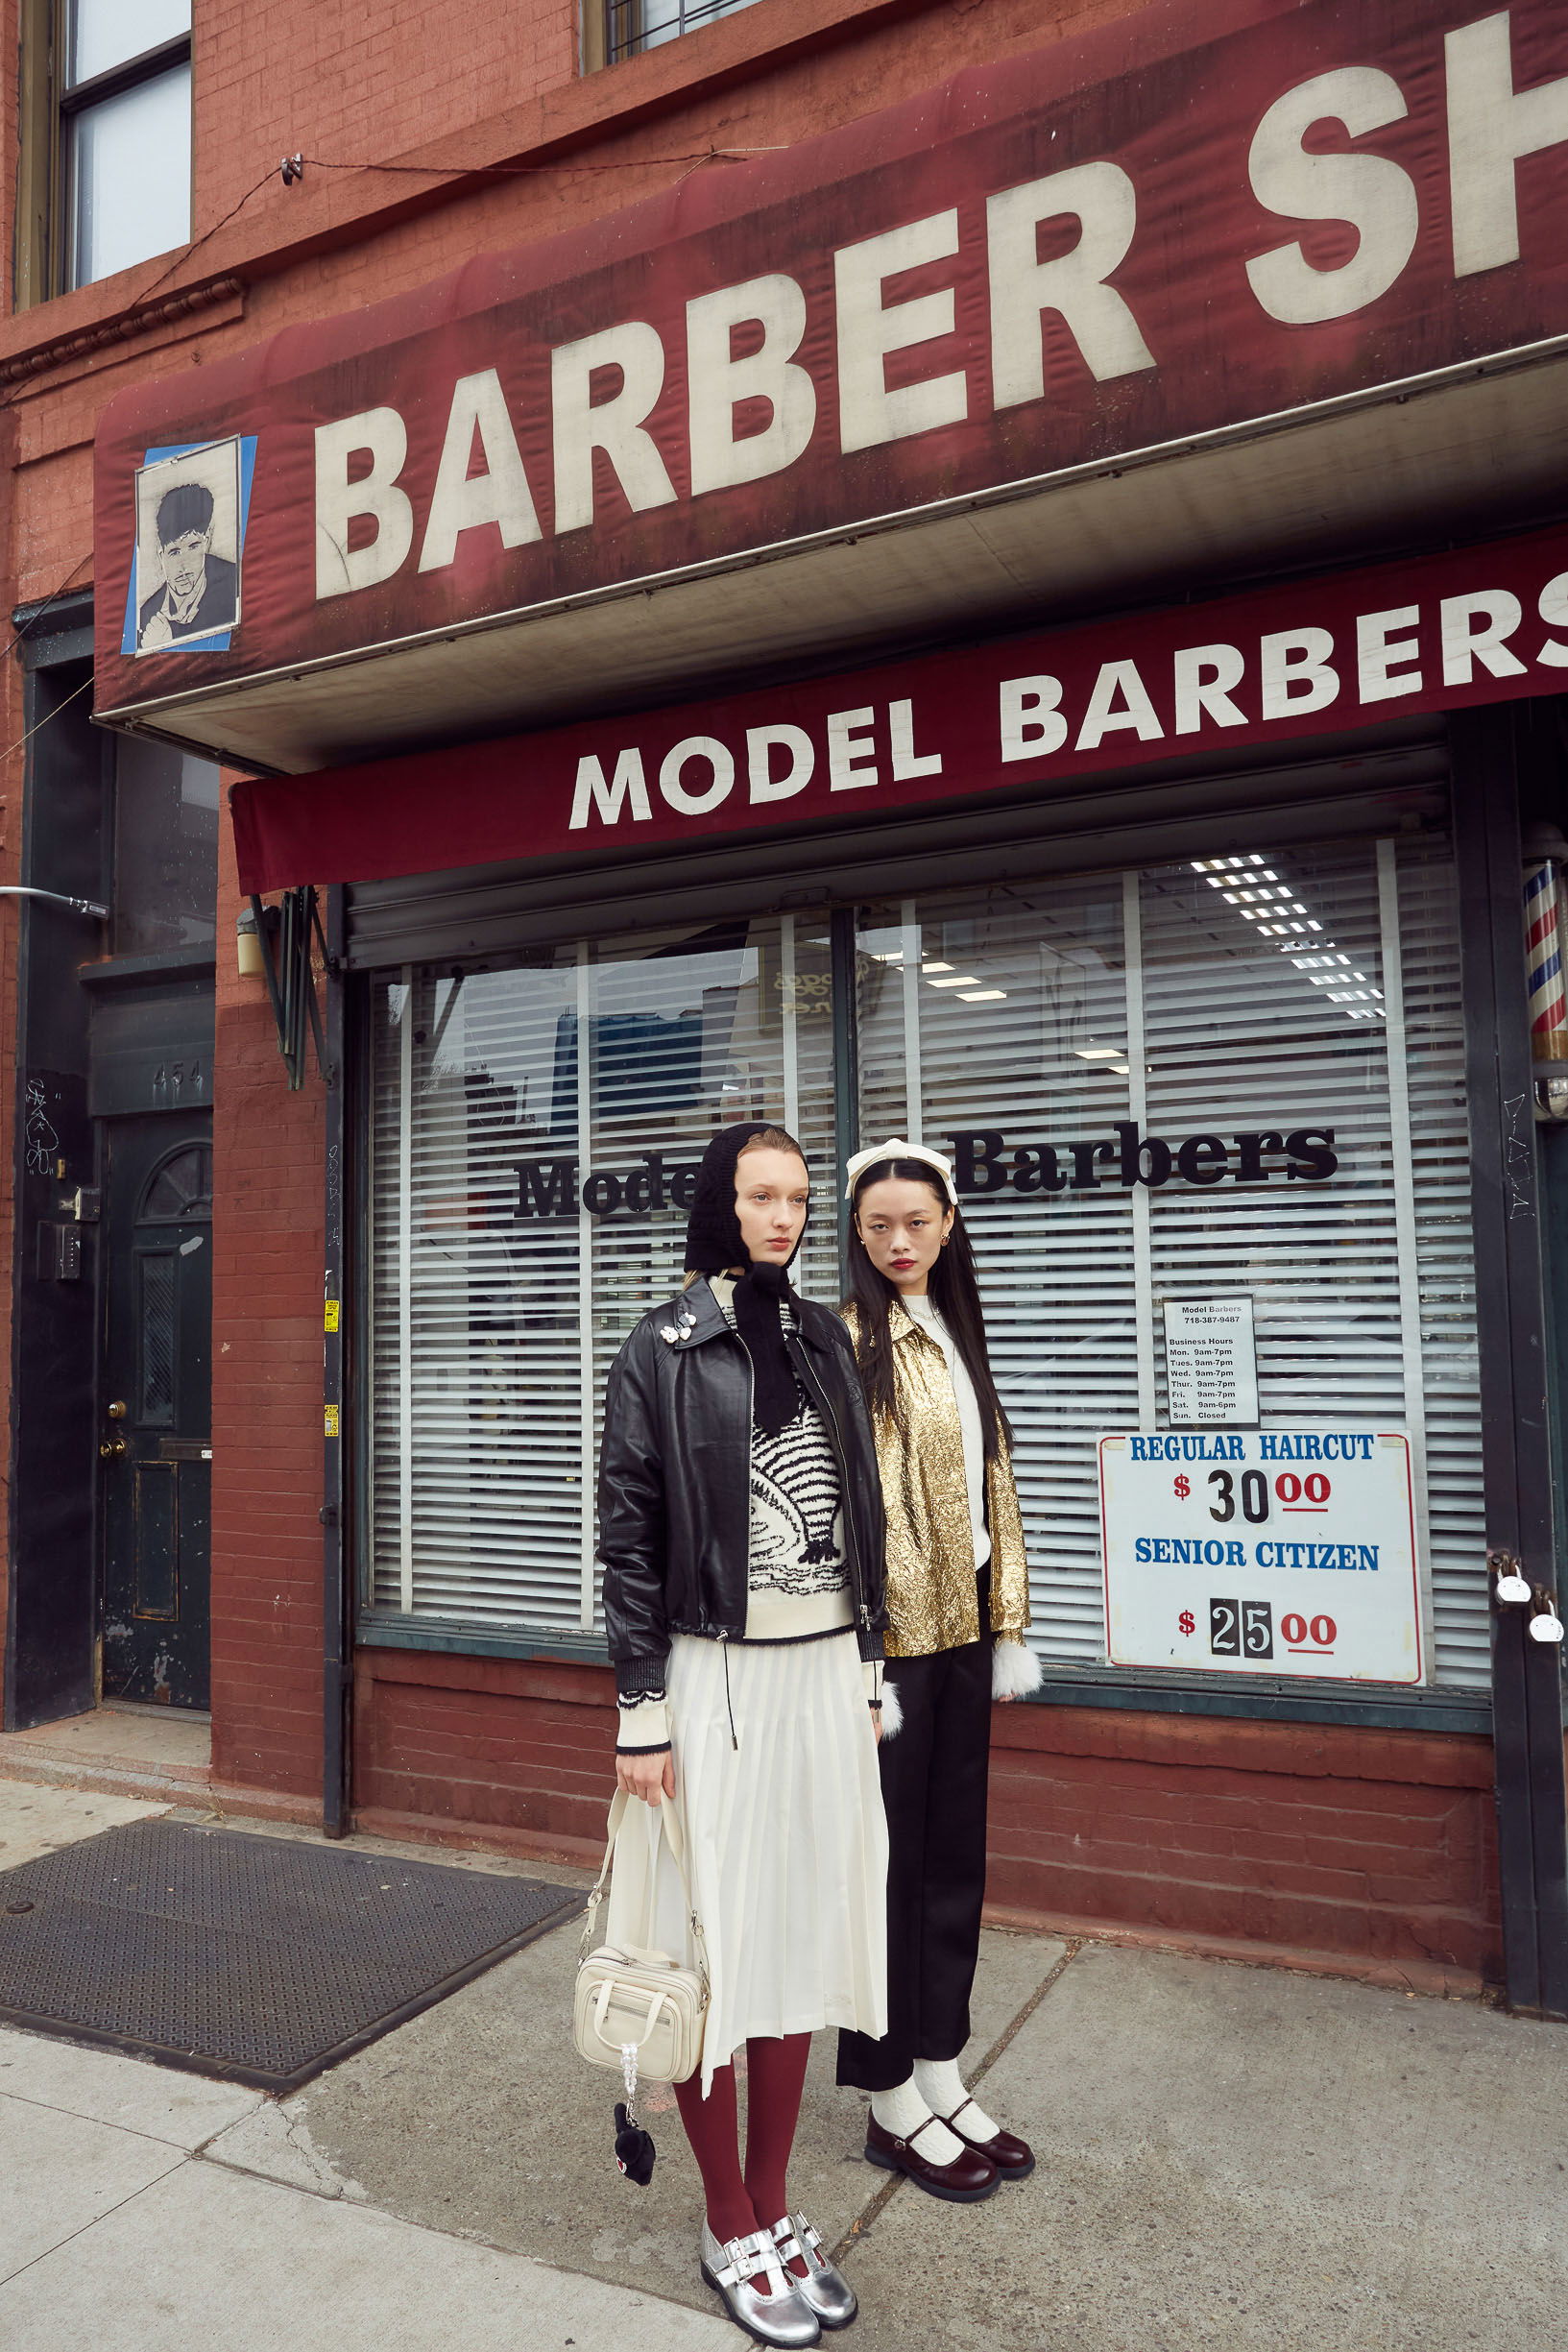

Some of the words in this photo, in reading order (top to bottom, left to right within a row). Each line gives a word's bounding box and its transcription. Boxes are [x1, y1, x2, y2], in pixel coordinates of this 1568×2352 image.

[315, 161, 1156, 601] BARBER
[568, 698, 943, 830] MODEL
[514, 1152, 701, 1218] Mode
[947, 1121, 1339, 1194] Barbers
[1184, 1316, 1241, 1324] 718-387-9487
[1194, 1348, 1232, 1357] 9am-7pm
[1130, 1435, 1246, 1462] REGULAR
[1260, 1434, 1374, 1461] HAIRCUT
[1173, 1474, 1191, 1500] $
[1135, 1538, 1247, 1567] SENIOR
[1255, 1541, 1380, 1572] CITIZEN
[1178, 1610, 1195, 1637] $
